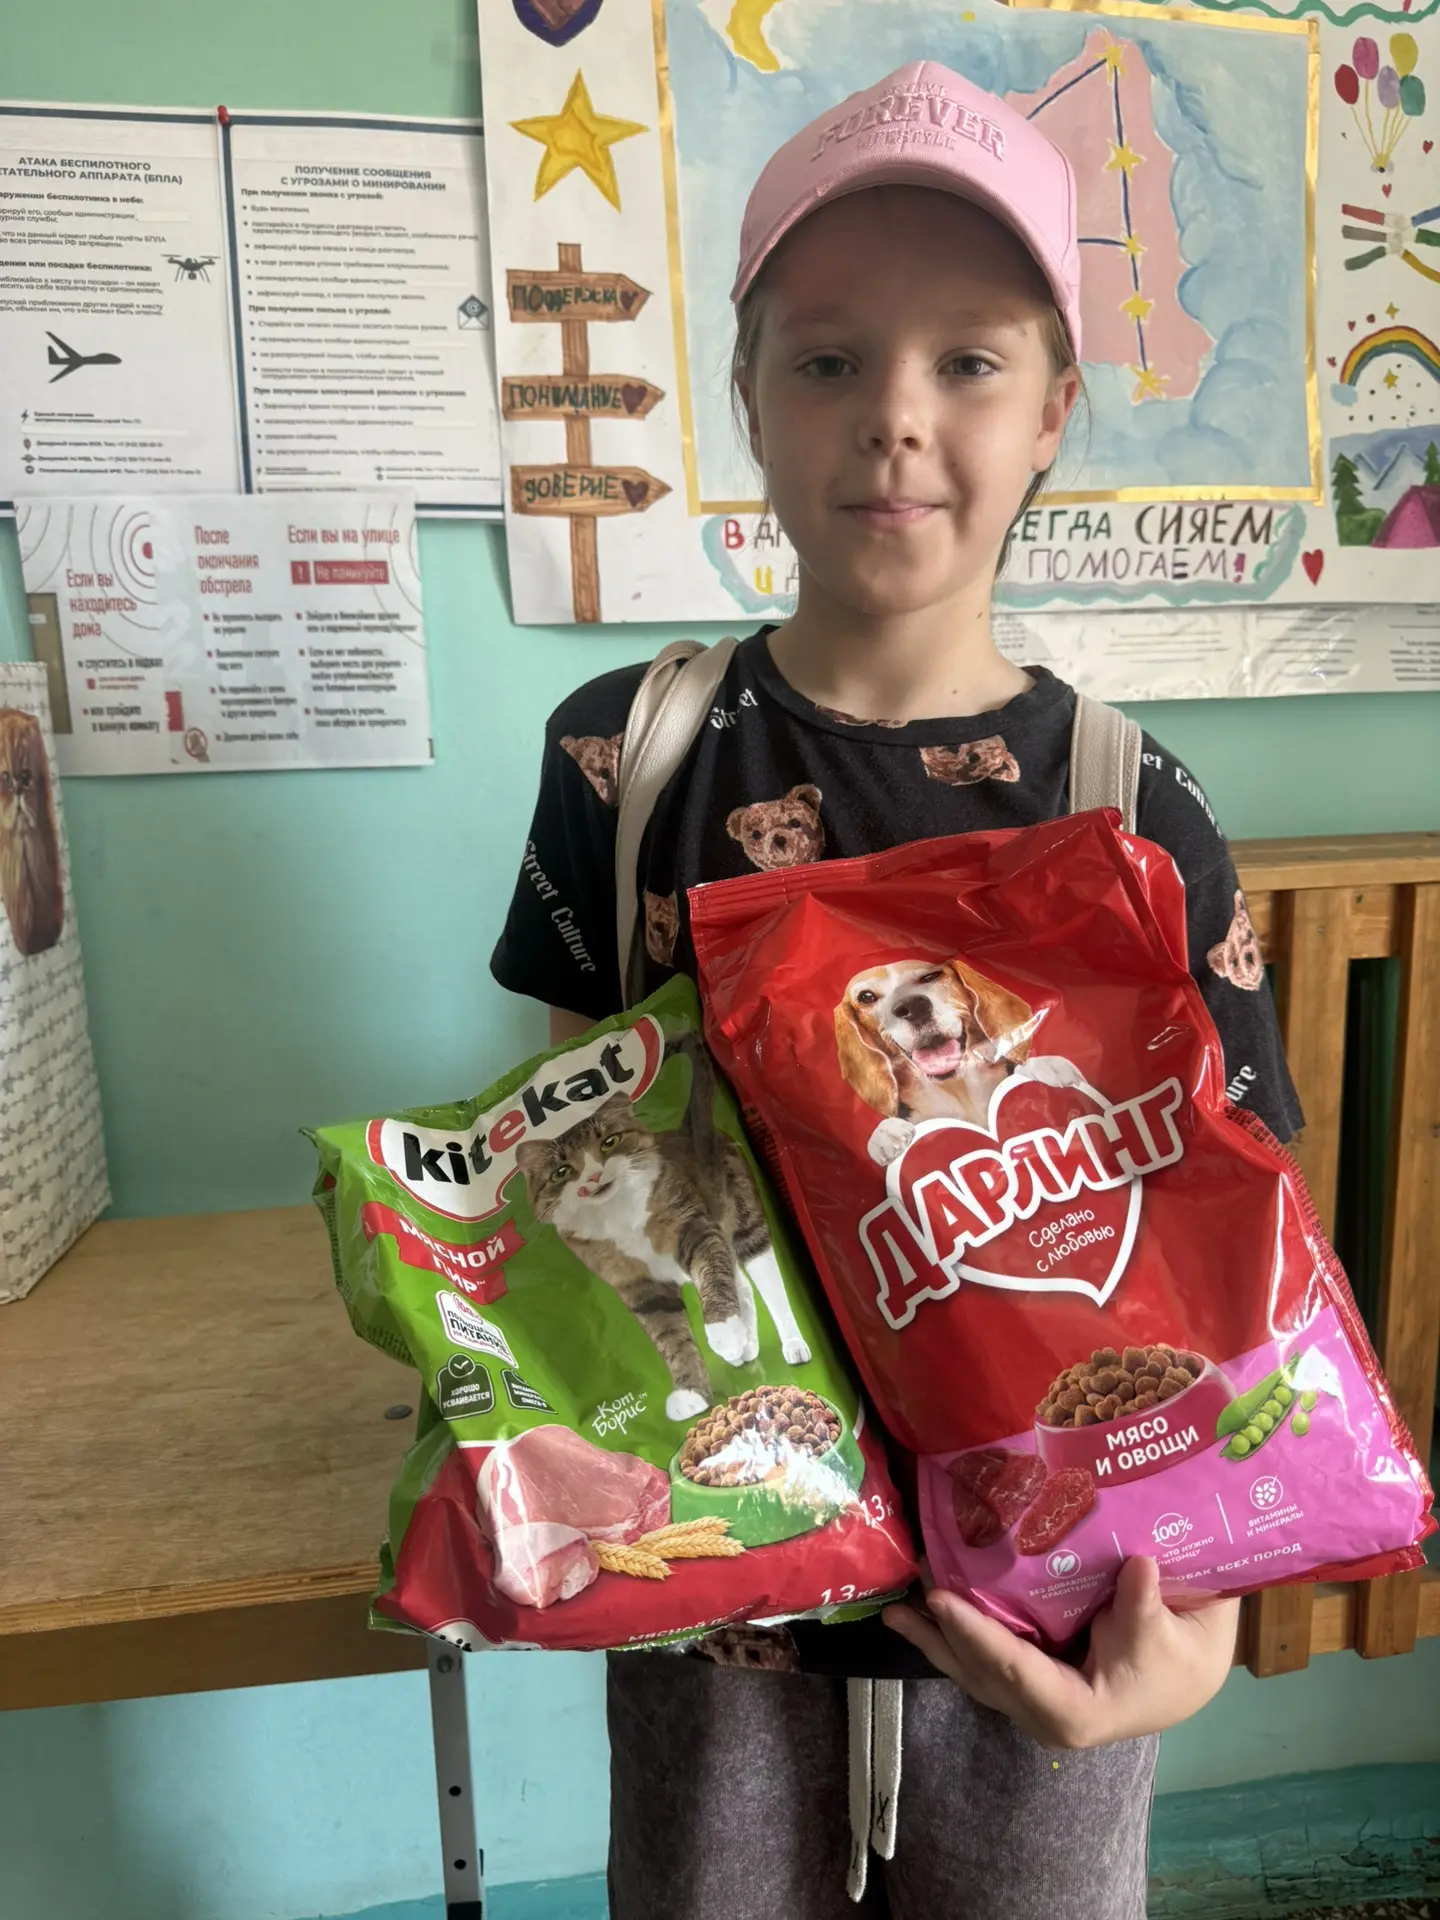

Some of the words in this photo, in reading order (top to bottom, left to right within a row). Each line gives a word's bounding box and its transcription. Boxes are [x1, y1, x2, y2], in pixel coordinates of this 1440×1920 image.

[810, 92, 1005, 163] FOREVER
[18, 157, 57, 167] АТАКА
[60, 159, 151, 171] БЕСПИЛОТНОГО
[295, 165, 360, 176] ПОЛУЧЕНИЕ
[362, 168, 432, 179] СООБЩЕНИЯ
[79, 171, 141, 182] АППАРАТА
[144, 173, 183, 185] (БПЛА)
[291, 177, 349, 187] УГРОЗАМИ
[362, 180, 447, 191] МИНИРОВАНИИ
[194, 525, 230, 546] После
[287, 525, 318, 544] Если
[320, 527, 340, 544] вы
[342, 528, 359, 544] на
[362, 528, 401, 547] улице
[724, 518, 745, 550] В
[1134, 503, 1273, 546] СИЯЕМ
[197, 553, 260, 570] окончания
[316, 565, 331, 580] Не
[1028, 547, 1246, 583] ПОМОГАЕМ!
[66, 568, 94, 588] Если
[96, 572, 115, 588] вы
[69, 596, 138, 613] находитесь
[72, 621, 103, 640] дома
[551, 906, 597, 973] Culture
[402, 1041, 635, 1186] kitekat
[859, 1077, 1184, 1331] ДАРЛИНГ
[1028, 1208, 1095, 1249] Сделано
[1036, 1259, 1049, 1273] с
[1048, 1224, 1116, 1265] любовью
[451, 1383, 480, 1397] ХОРОШО
[596, 1391, 635, 1419] Кот
[1105, 1416, 1170, 1451] МЯСО
[1095, 1458, 1113, 1477] И
[1117, 1425, 1200, 1470] ОВОЩИ
[1247, 1503, 1298, 1528] ВИТАМИНЫ
[1255, 1511, 1305, 1535] МИНЕРАЛЫ
[1151, 1516, 1194, 1544] 100%
[1181, 1536, 1215, 1553] НУЖНО
[1216, 1557, 1251, 1573] ВСЕХ
[1254, 1541, 1304, 1562] ПОРОД
